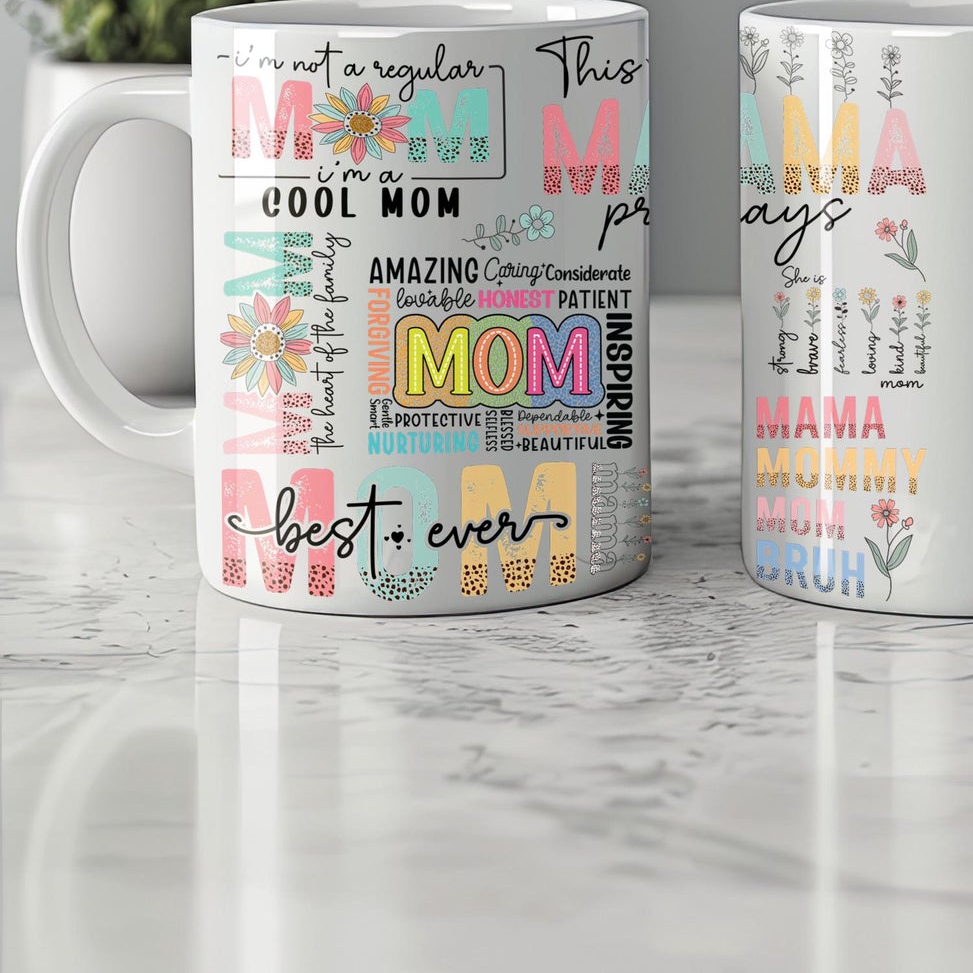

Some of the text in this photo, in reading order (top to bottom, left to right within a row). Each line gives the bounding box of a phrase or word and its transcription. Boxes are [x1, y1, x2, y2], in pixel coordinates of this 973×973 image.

[293, 41, 484, 102] not a regular
[535, 35, 643, 99] This
[260, 185, 460, 219] COOL MOM
[368, 257, 632, 287] AMAZING Caring Considerate
[782, 265, 810, 288] She
[396, 288, 632, 312] lovable HONEST PATIENT
[310, 231, 352, 417] heart of family
[366, 288, 390, 396] FORGIVING
[402, 324, 596, 397] MOM
[768, 329, 800, 375] strong
[796, 332, 820, 375] brave
[888, 341, 906, 375] kind
[605, 311, 634, 450] INSPIRING
[880, 379, 924, 389] mom
[755, 395, 886, 440] MAMA
[755, 446, 927, 495] MOMMY
[227, 483, 569, 580] best ever
[755, 495, 846, 541] MOM
[754, 539, 865, 599] BRUH
